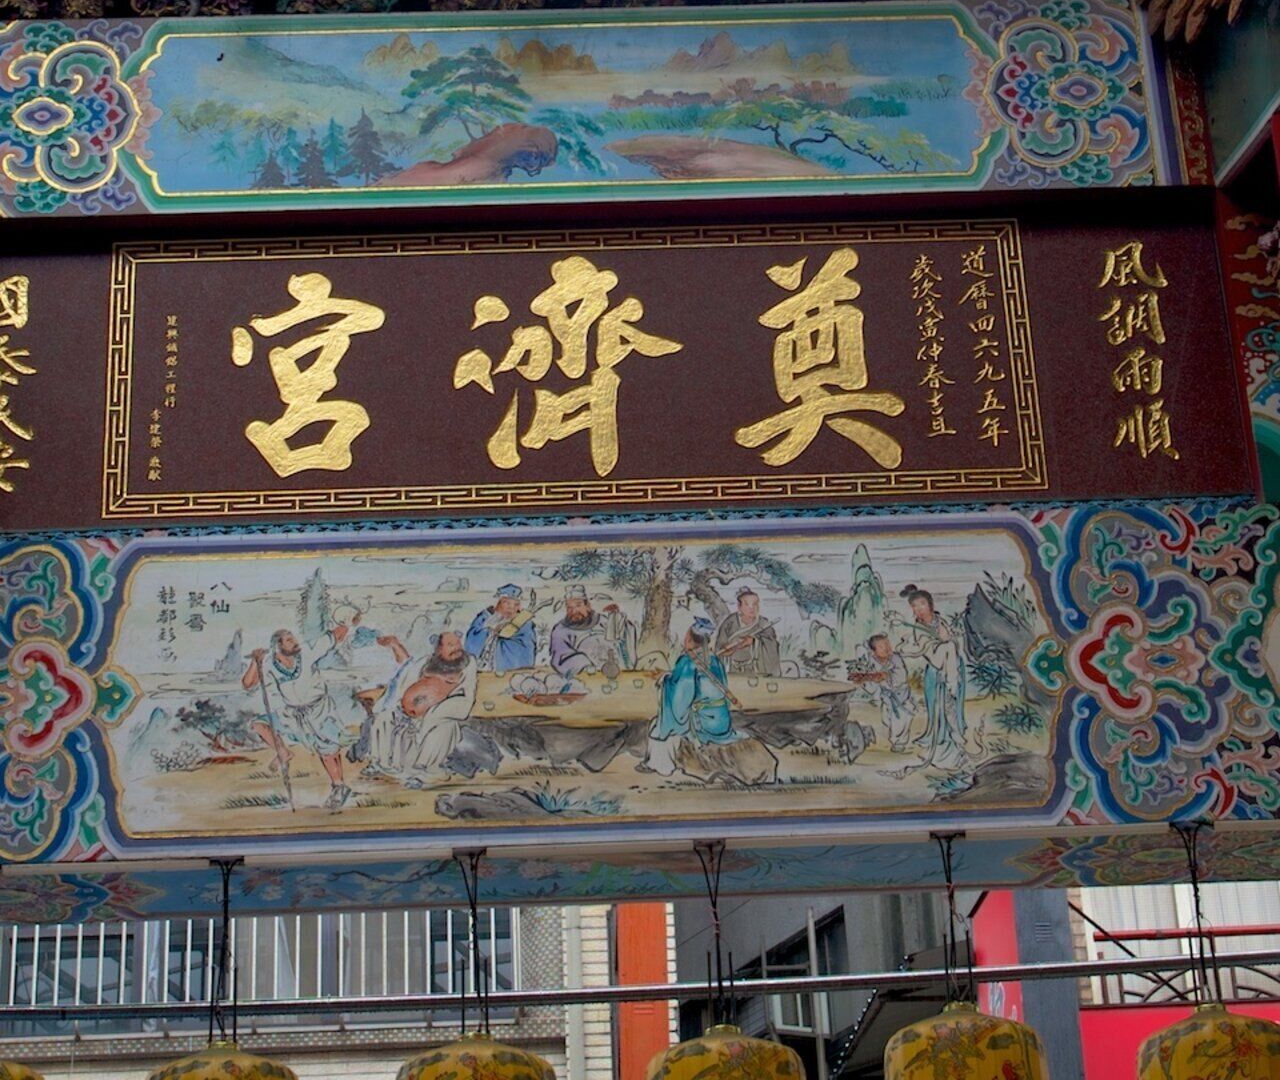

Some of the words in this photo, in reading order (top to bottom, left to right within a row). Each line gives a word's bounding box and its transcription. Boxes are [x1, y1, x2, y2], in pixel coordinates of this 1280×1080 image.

[230, 247, 906, 478] 奠濟宮
[1099, 242, 1179, 460] 風調雨順
[210, 581, 233, 614] 八仙
